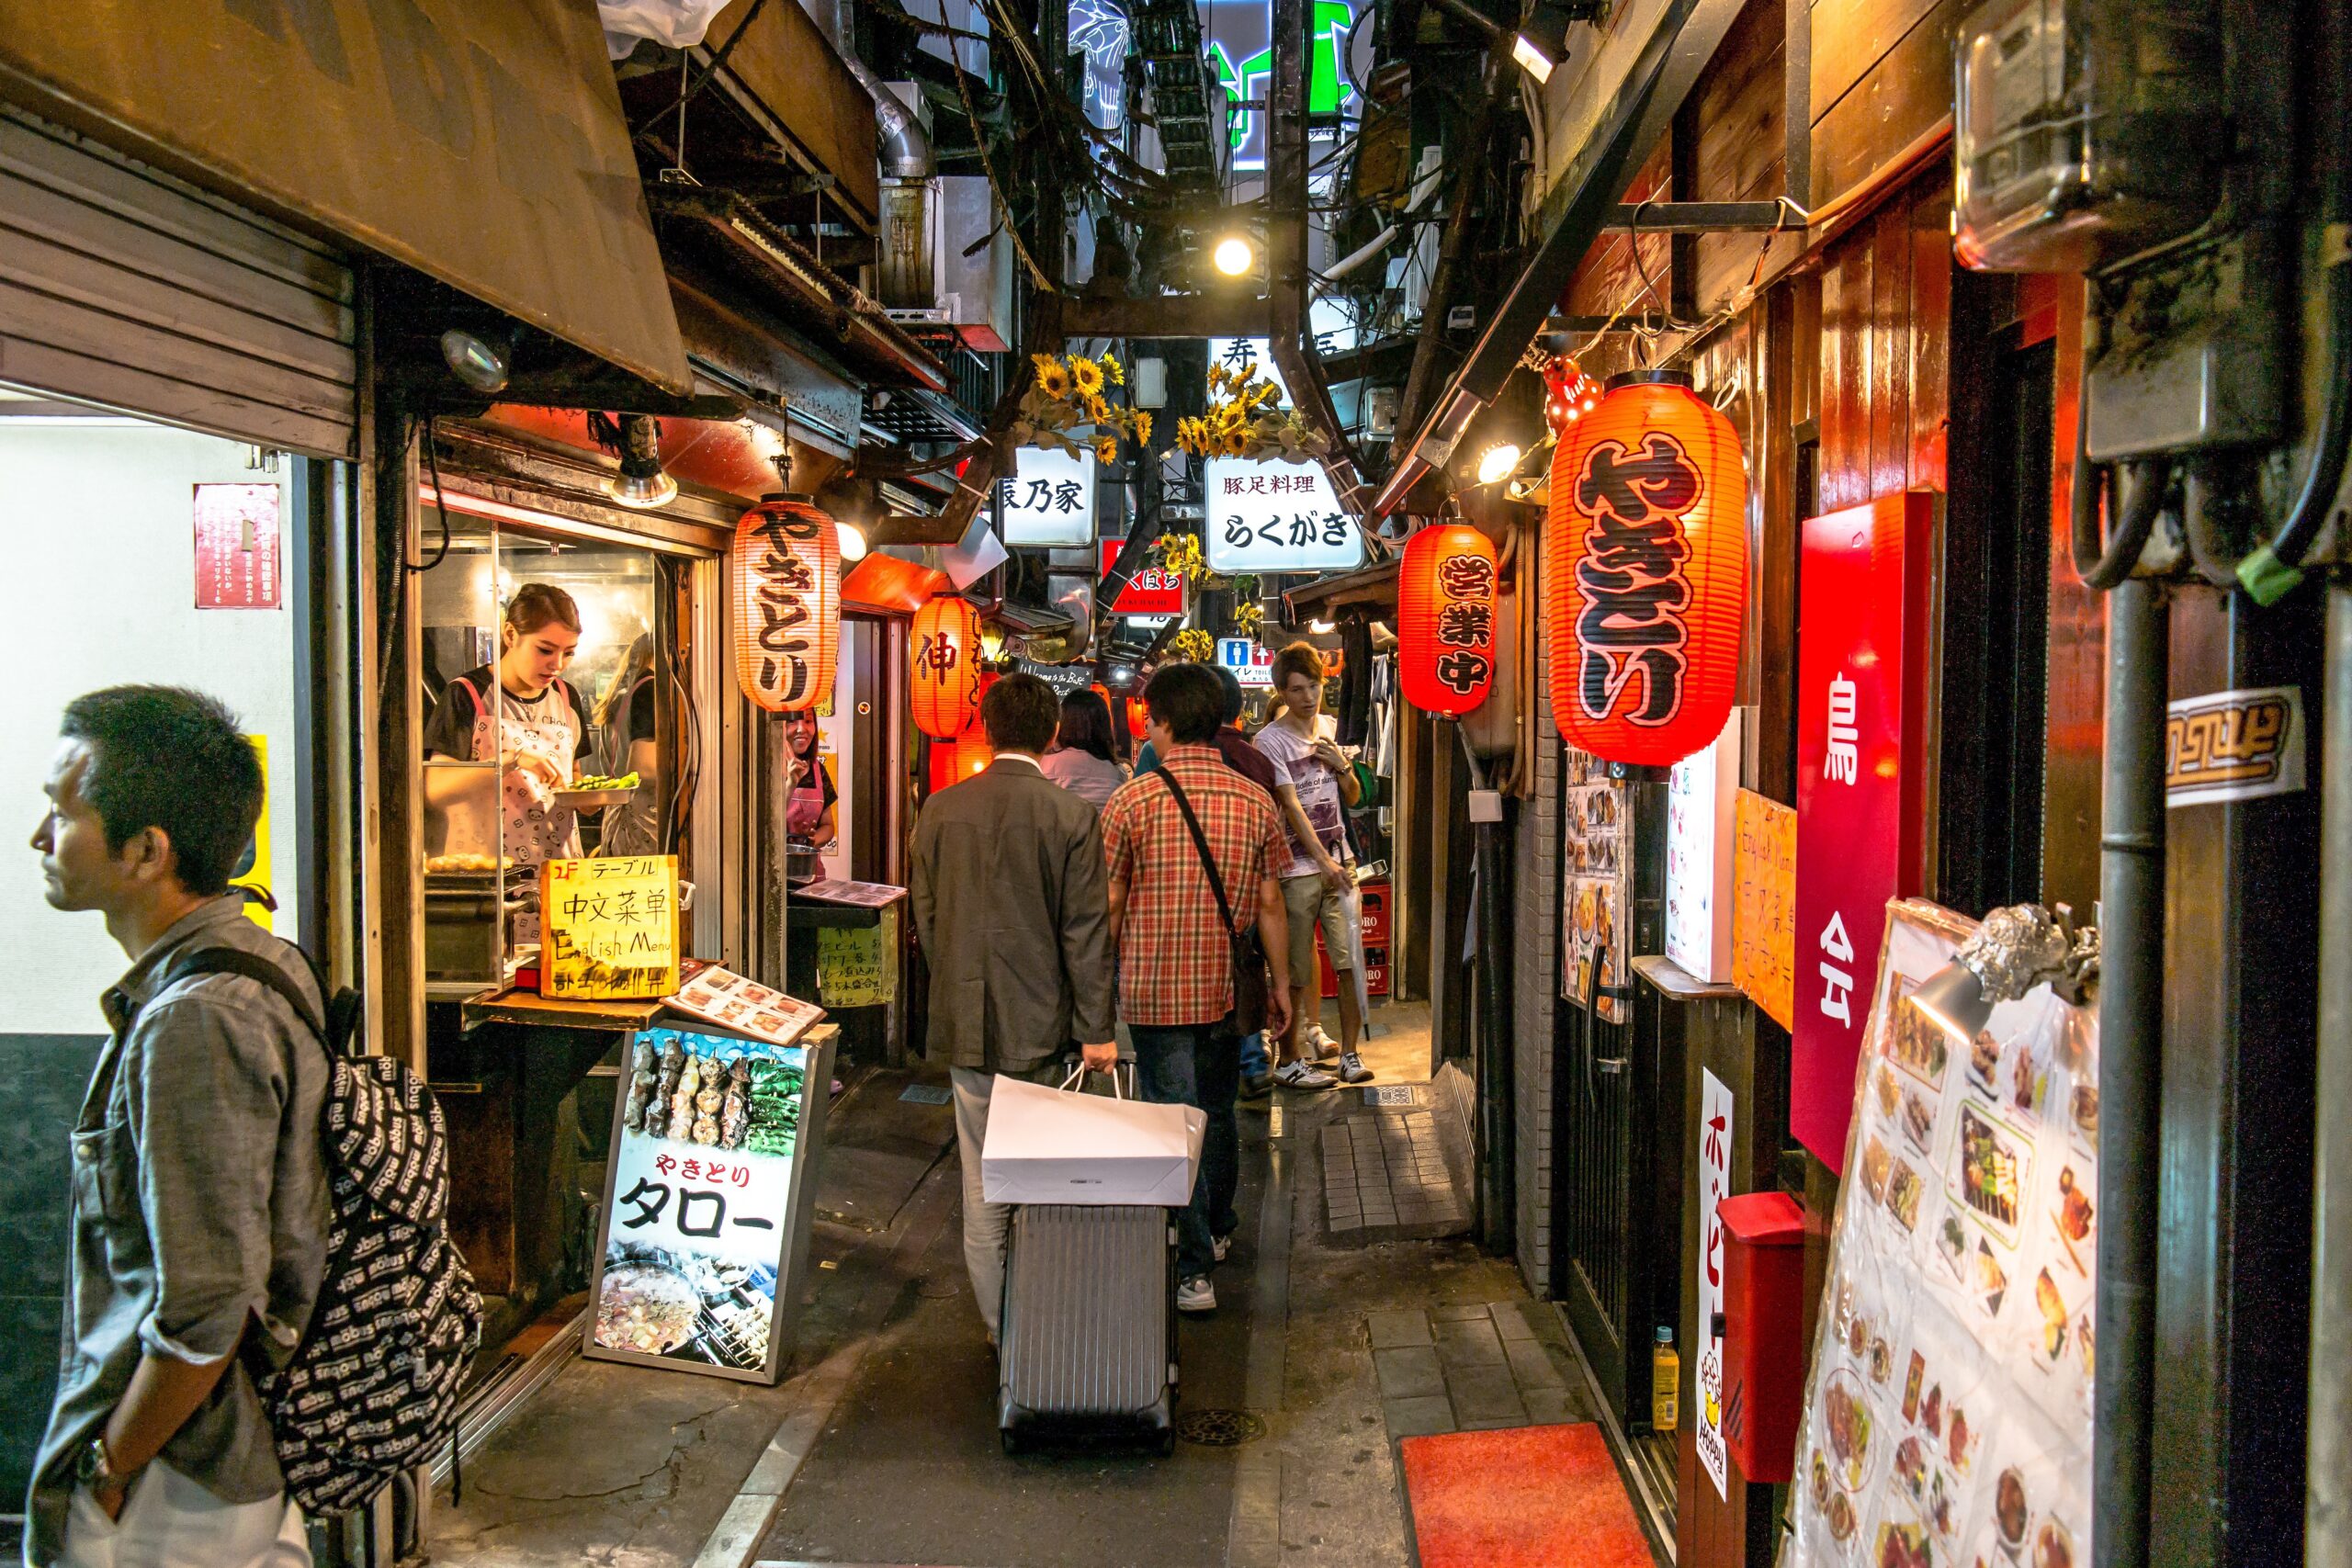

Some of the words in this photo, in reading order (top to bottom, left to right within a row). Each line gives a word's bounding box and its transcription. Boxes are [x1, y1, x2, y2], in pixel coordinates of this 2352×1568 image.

[1223, 475, 1316, 495] 豚足料理
[1225, 511, 1347, 547] らくがき
[750, 511, 819, 702] やきとり
[1574, 432, 1704, 727] やきとり
[1437, 554, 1494, 694] 営業中
[916, 631, 956, 686] 伸
[554, 862, 578, 880] 2F
[593, 859, 655, 878] テーブル
[629, 931, 671, 953] Menu
[656, 1154, 750, 1188] やきとり
[620, 1177, 774, 1238] タロー
[1699, 1415, 1724, 1474] Hoppy
